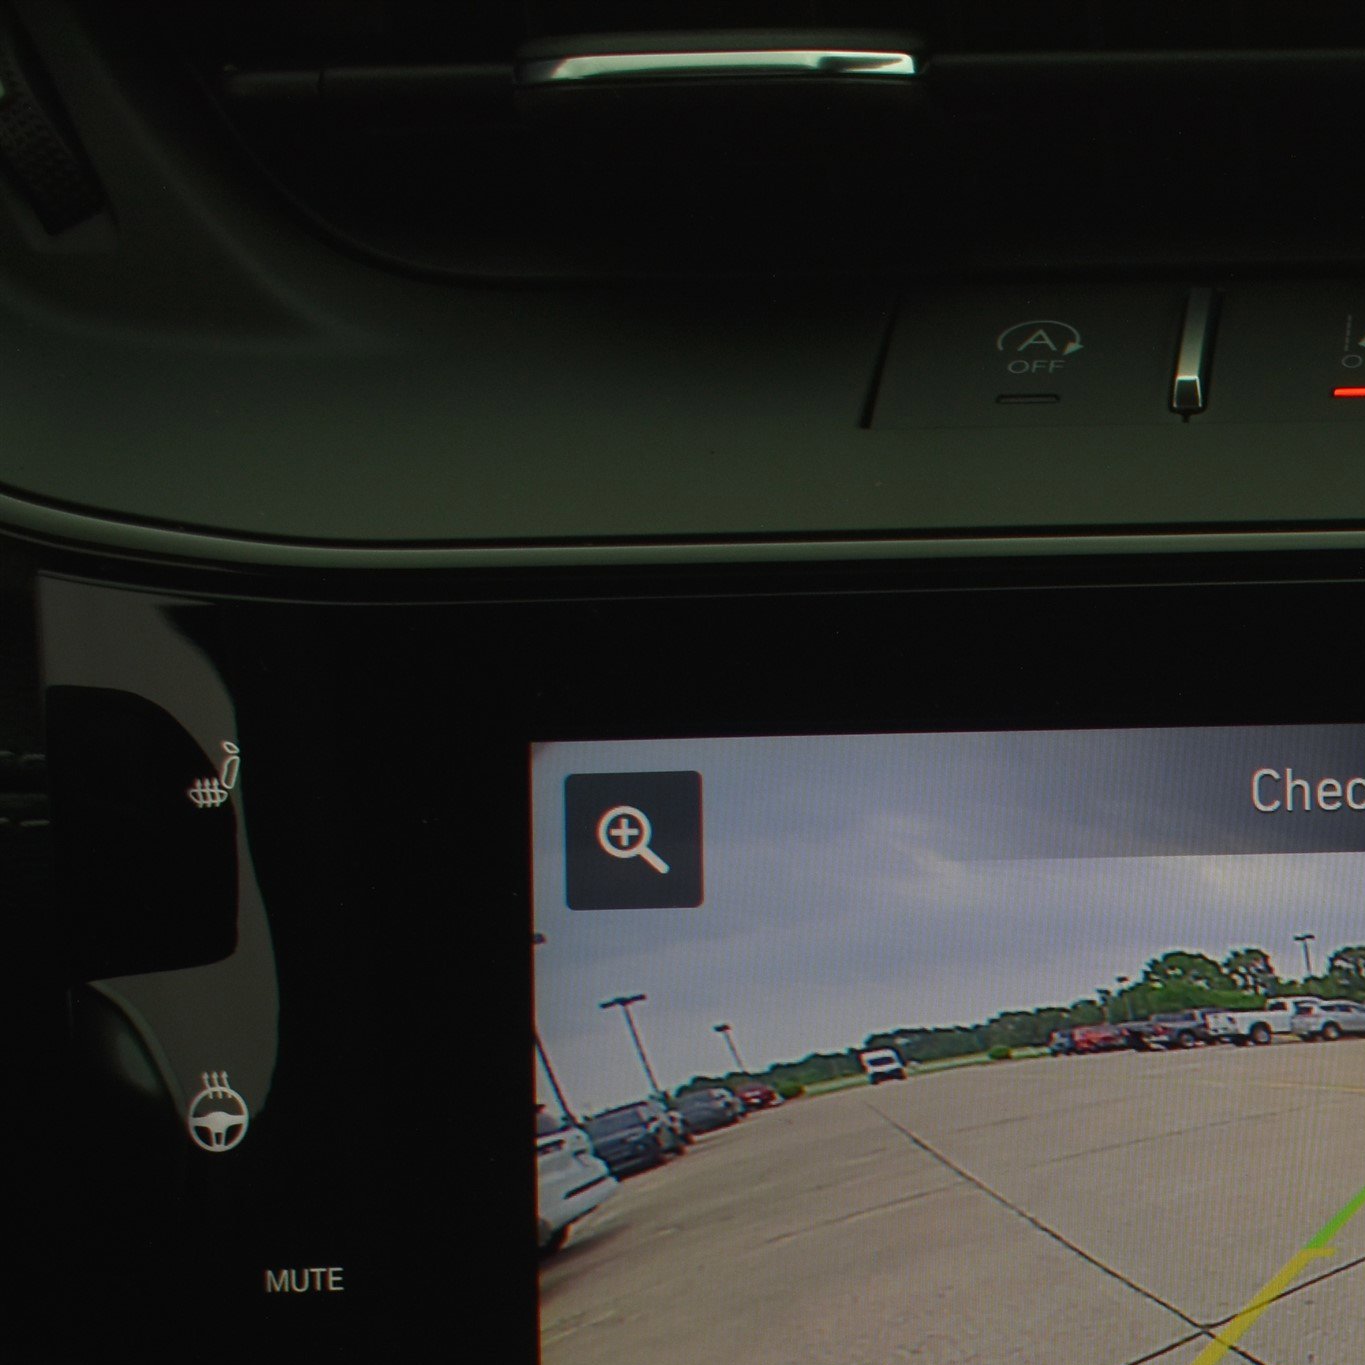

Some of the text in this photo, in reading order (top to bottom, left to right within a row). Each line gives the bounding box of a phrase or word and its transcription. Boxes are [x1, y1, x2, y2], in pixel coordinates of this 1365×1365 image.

[1016, 328, 1058, 352] A
[1007, 359, 1066, 374] OFF
[265, 1267, 345, 1293] MUTE
